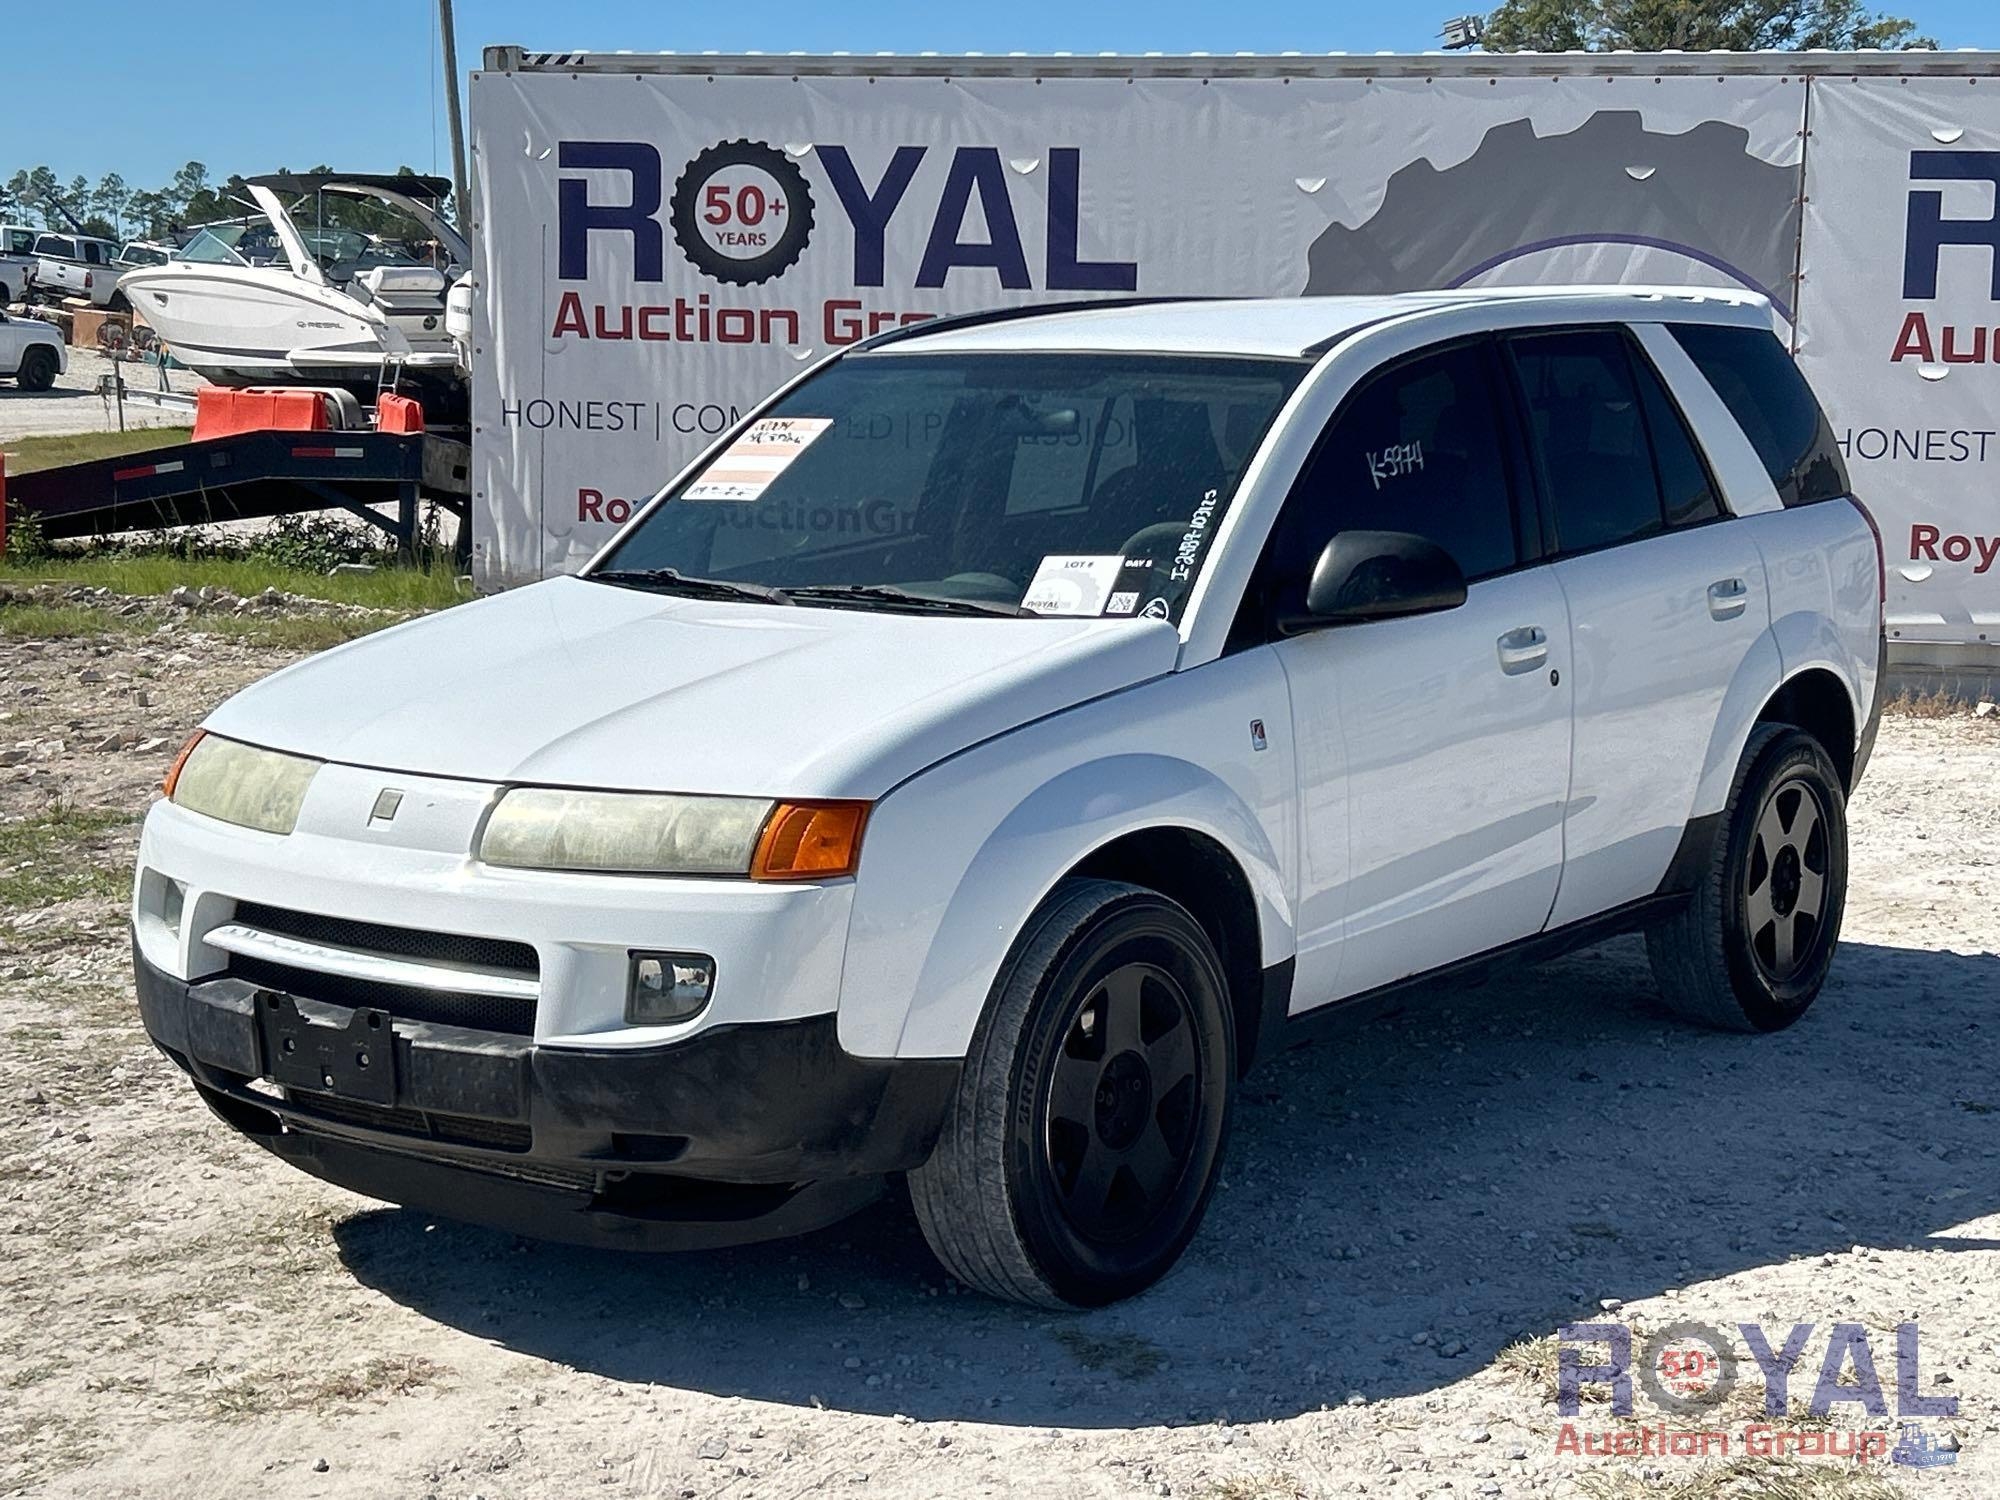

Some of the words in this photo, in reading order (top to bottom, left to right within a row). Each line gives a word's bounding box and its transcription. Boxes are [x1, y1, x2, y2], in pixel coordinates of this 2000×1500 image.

[703, 185, 786, 226] 50+
[716, 232, 767, 246] YEARS
[552, 291, 799, 344] Auction
[502, 398, 646, 431] HONEST
[1064, 560, 1085, 569] LOT
